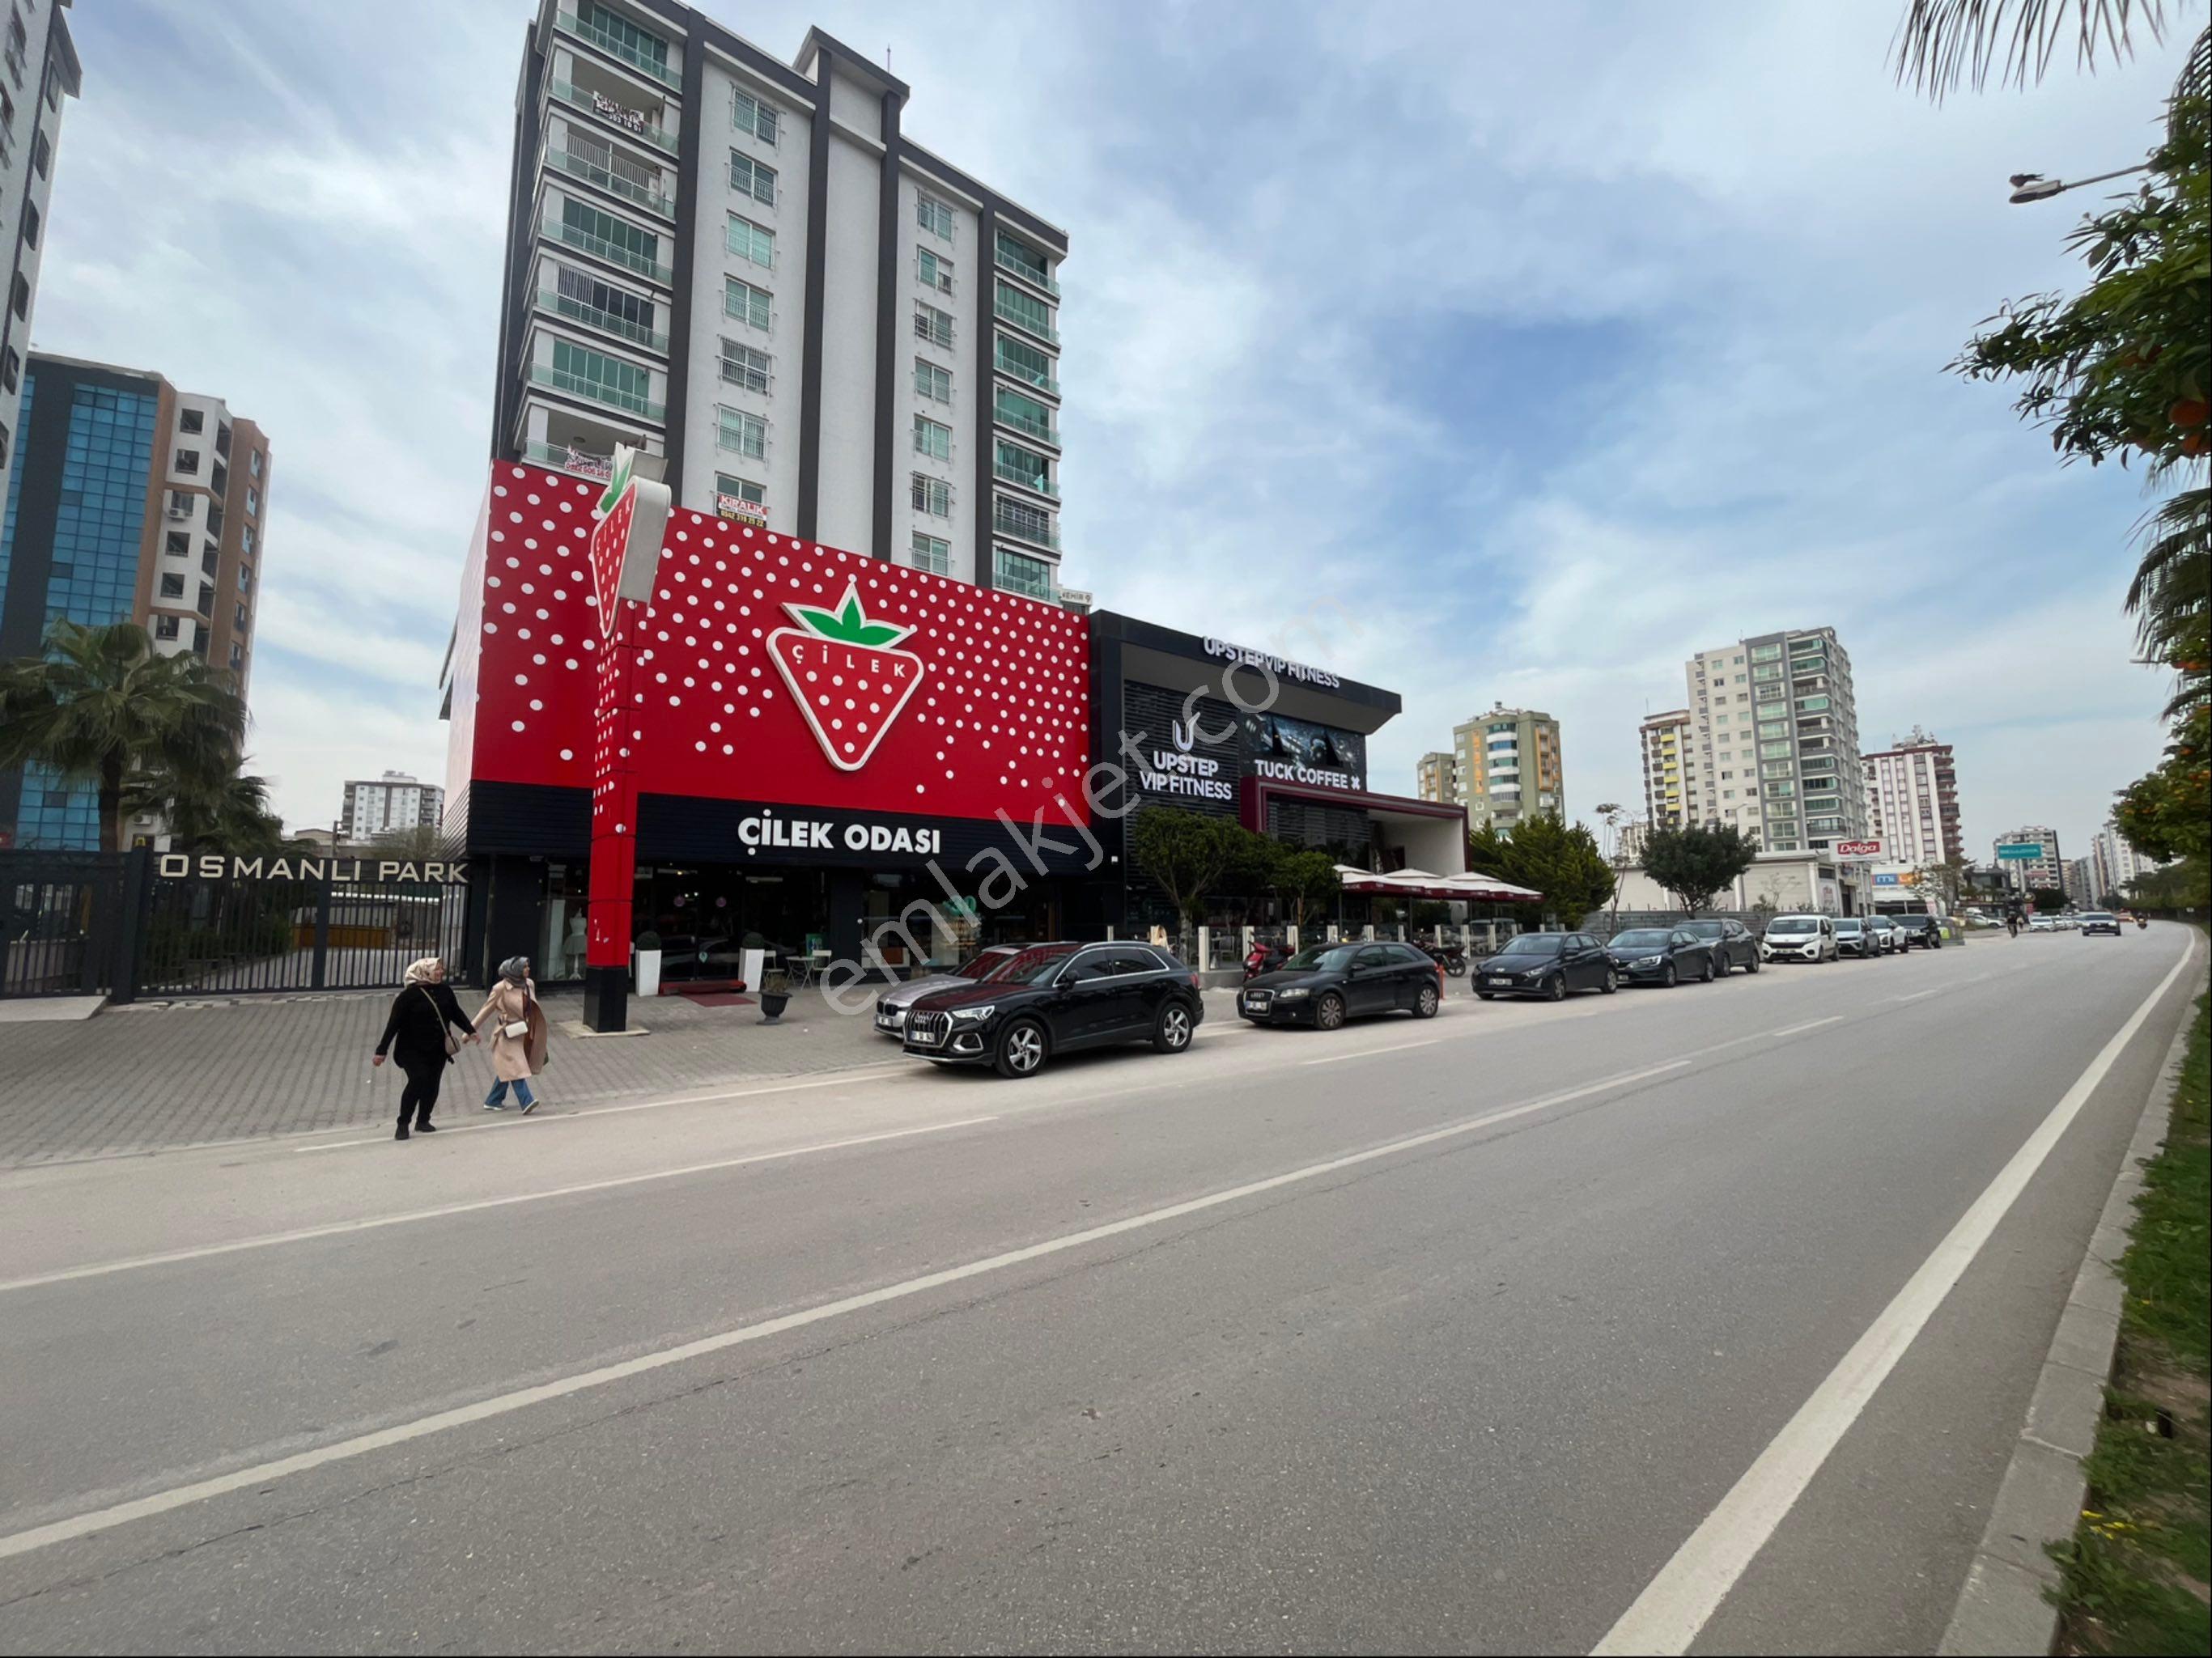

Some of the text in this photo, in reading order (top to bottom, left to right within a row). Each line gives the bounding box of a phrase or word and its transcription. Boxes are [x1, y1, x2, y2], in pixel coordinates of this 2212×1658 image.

[792, 644, 906, 678] ÇİLEK
[1203, 636, 1340, 689] UPSTEP VIP FITNESS
[1153, 750, 1219, 777] UPSTEP
[1255, 758, 1349, 790] TUCK COFFEE
[1140, 770, 1233, 800] VIP FITNESS
[737, 809, 940, 855] ÇİLEK ODASI
[1840, 843, 1878, 855] Dalga
[160, 854, 469, 884] OSMANLI PARK
